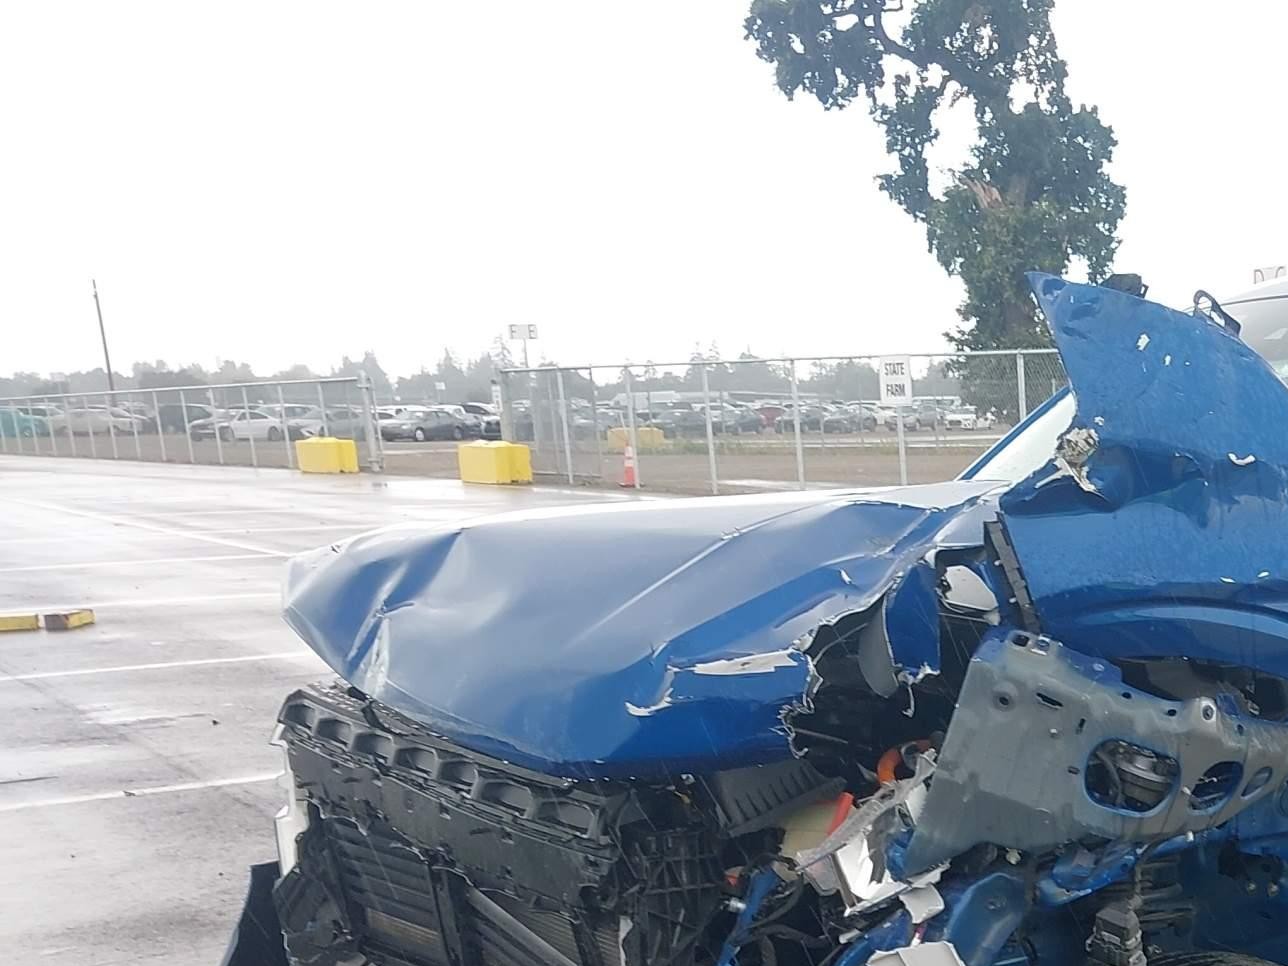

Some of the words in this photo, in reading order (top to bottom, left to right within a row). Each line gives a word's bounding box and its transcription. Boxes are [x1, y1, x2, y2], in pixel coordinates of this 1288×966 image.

[527, 323, 537, 340] E
[884, 362, 905, 376] STATE
[885, 383, 906, 397] FARM
